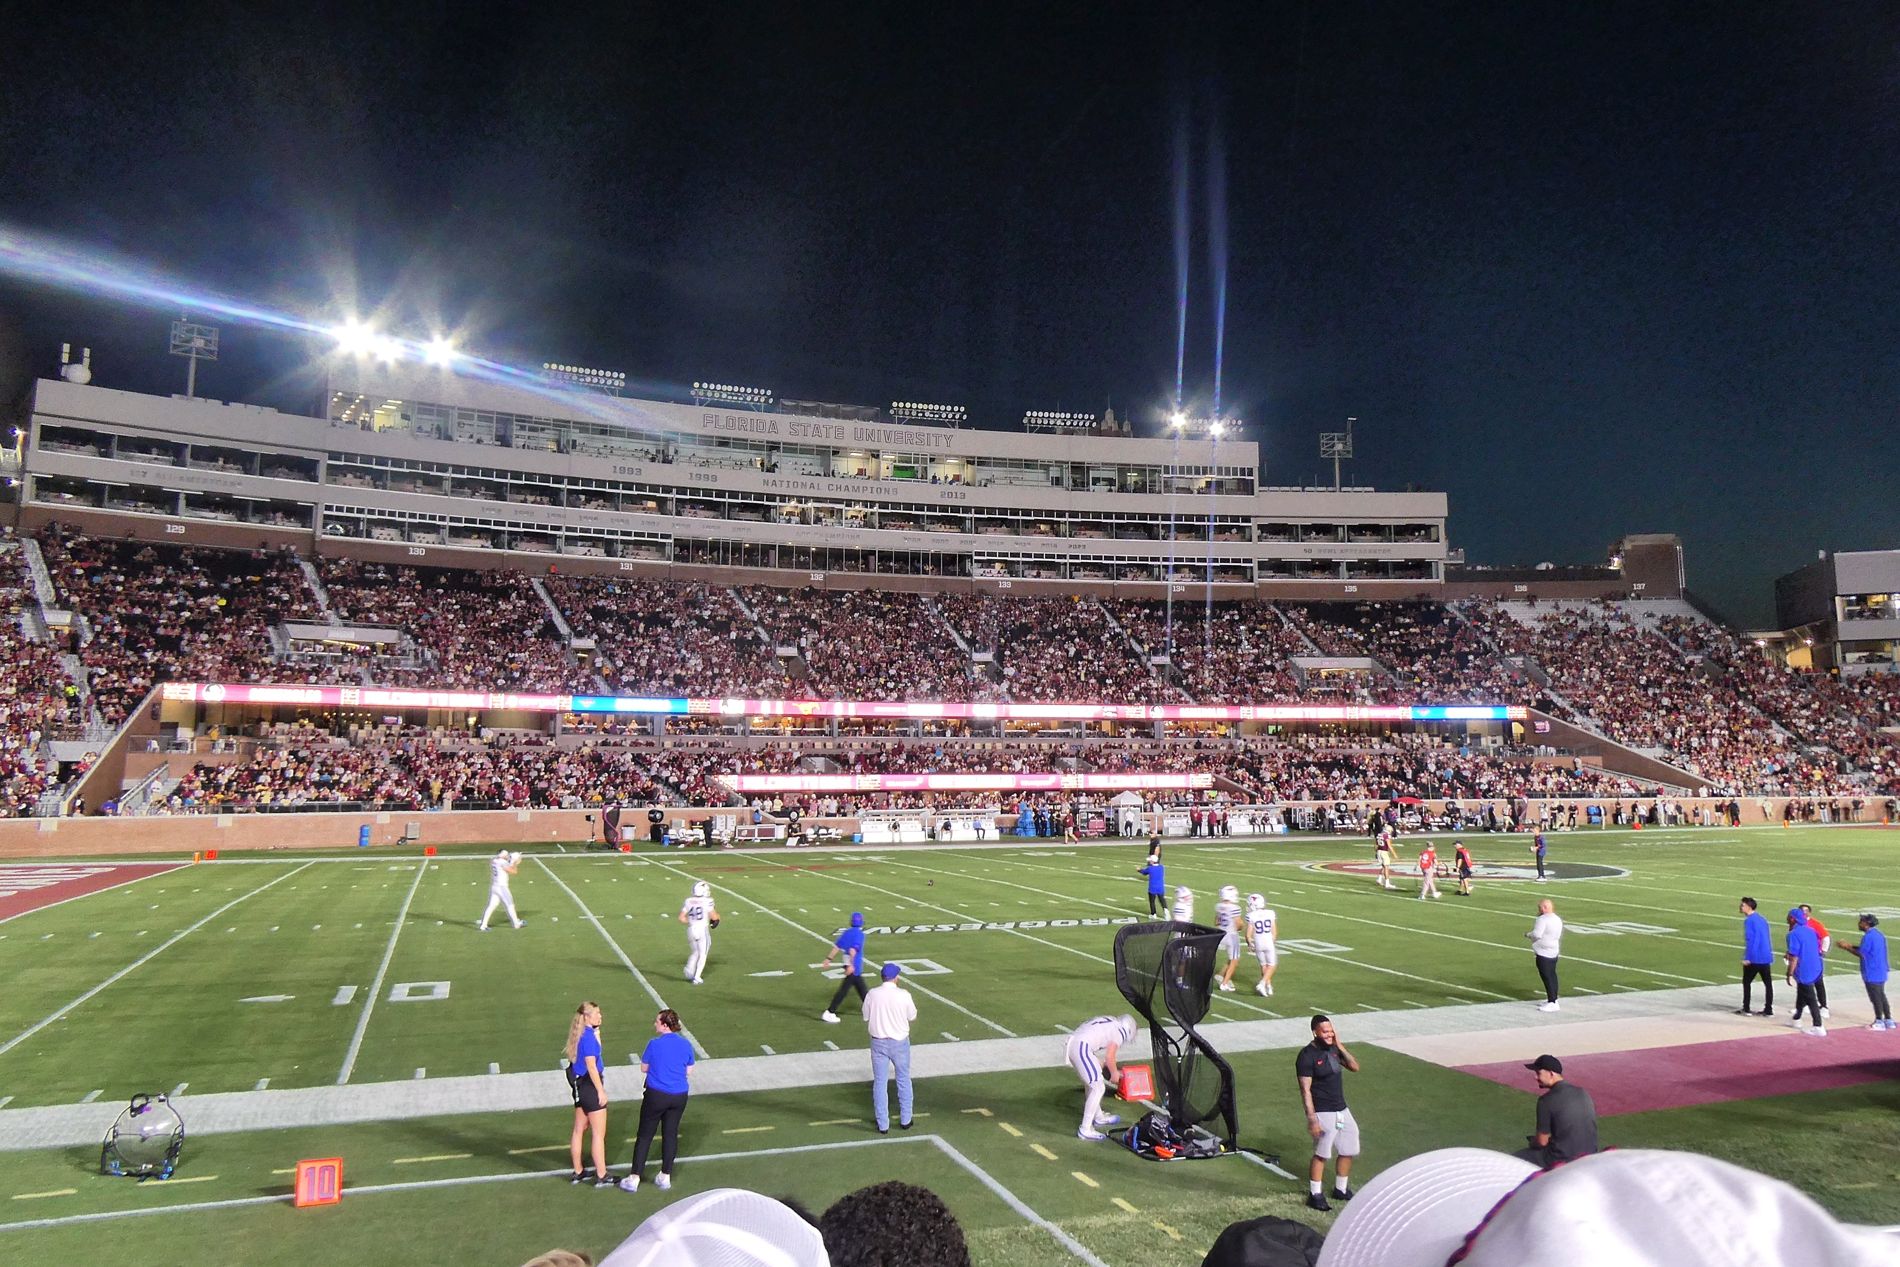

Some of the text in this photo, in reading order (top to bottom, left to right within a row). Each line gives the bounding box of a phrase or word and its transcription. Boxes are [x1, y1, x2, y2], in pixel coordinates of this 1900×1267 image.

[703, 413, 954, 448] FLORIDA STATE UNIVERSITY
[612, 465, 643, 476] 1993
[688, 472, 718, 483] 1999
[762, 478, 898, 495] NATIONAL CHAMPIONS
[940, 490, 966, 499] 2013
[165, 523, 186, 534] 129
[408, 547, 426, 556] 130
[619, 562, 633, 571] 131
[810, 573, 824, 581] 132
[1172, 585, 1185, 593] 134
[688, 906, 704, 920] 48
[1254, 919, 1273, 934] 99
[303, 1164, 336, 1202] 10
